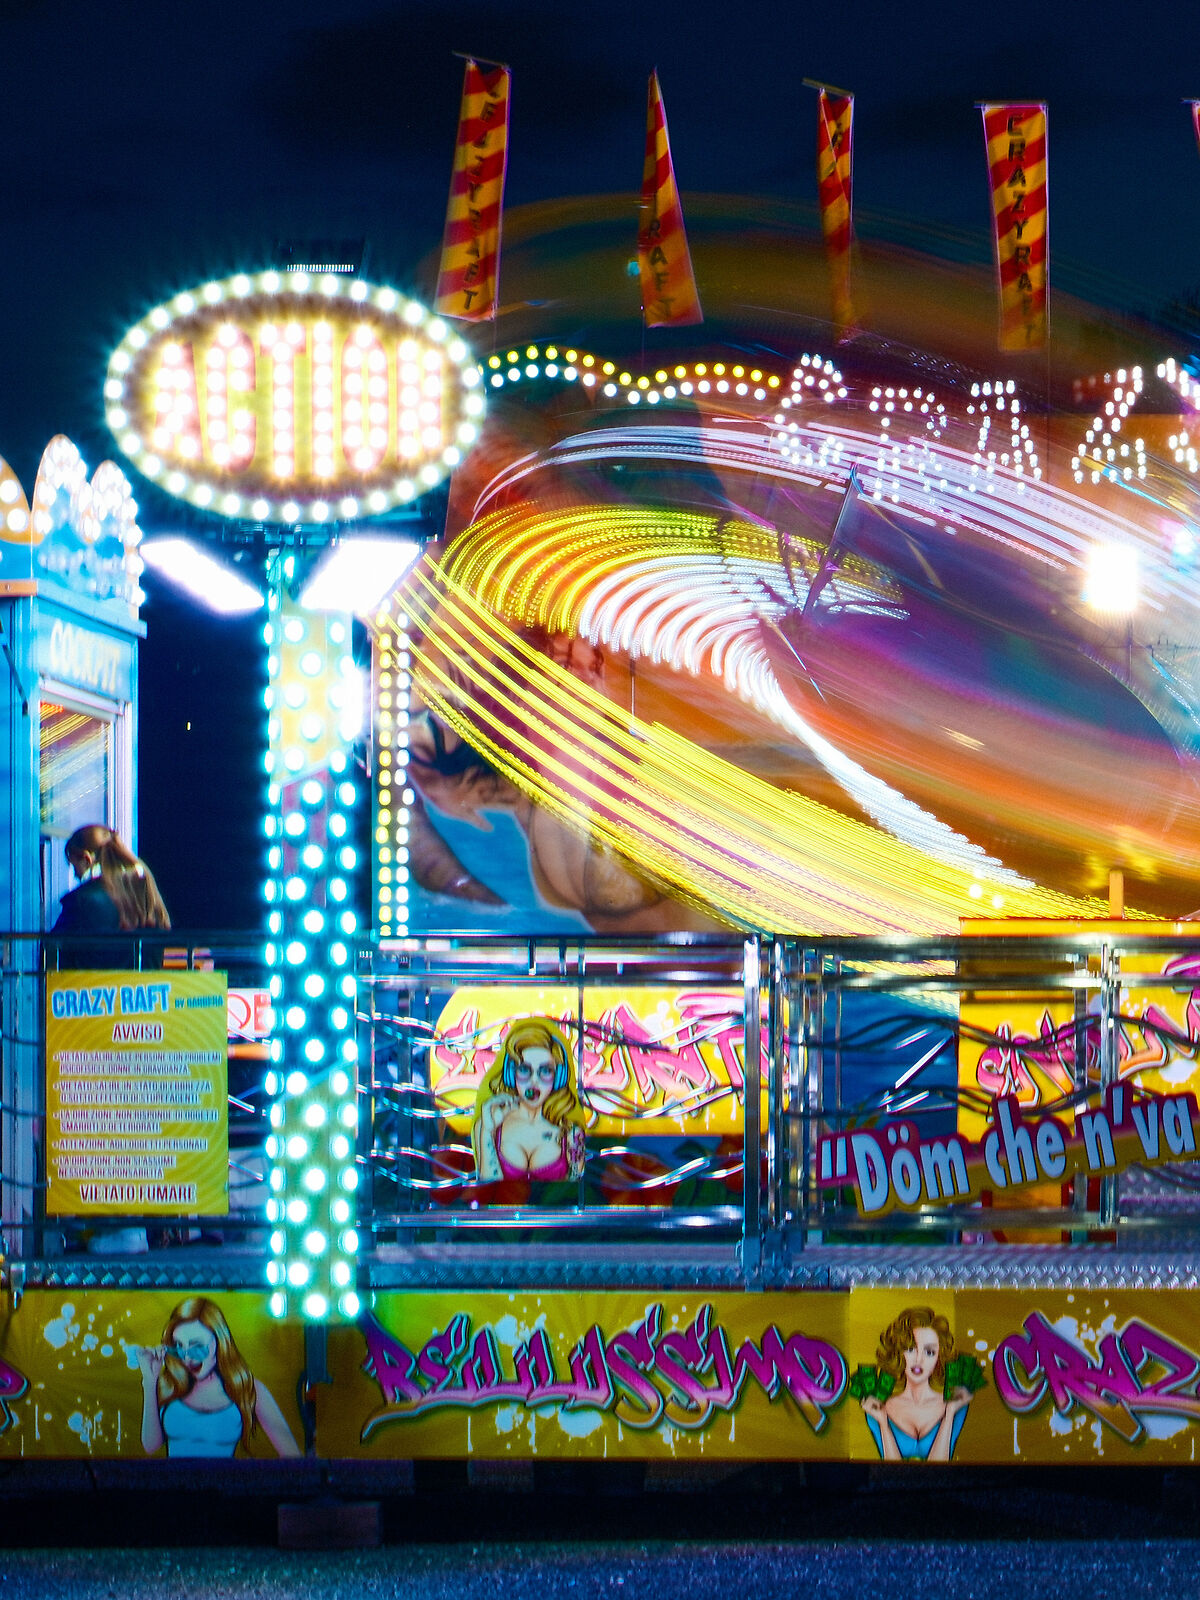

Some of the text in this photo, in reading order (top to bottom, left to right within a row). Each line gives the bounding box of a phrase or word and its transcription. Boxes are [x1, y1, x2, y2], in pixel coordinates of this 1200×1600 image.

[152, 320, 447, 481] ACTION
[52, 986, 118, 1018] CRAZY
[120, 982, 171, 1015] RAFT
[112, 1023, 164, 1043] AVVISO
[984, 1099, 1067, 1188] che
[80, 1184, 197, 1203] VIETATO FUMARE
